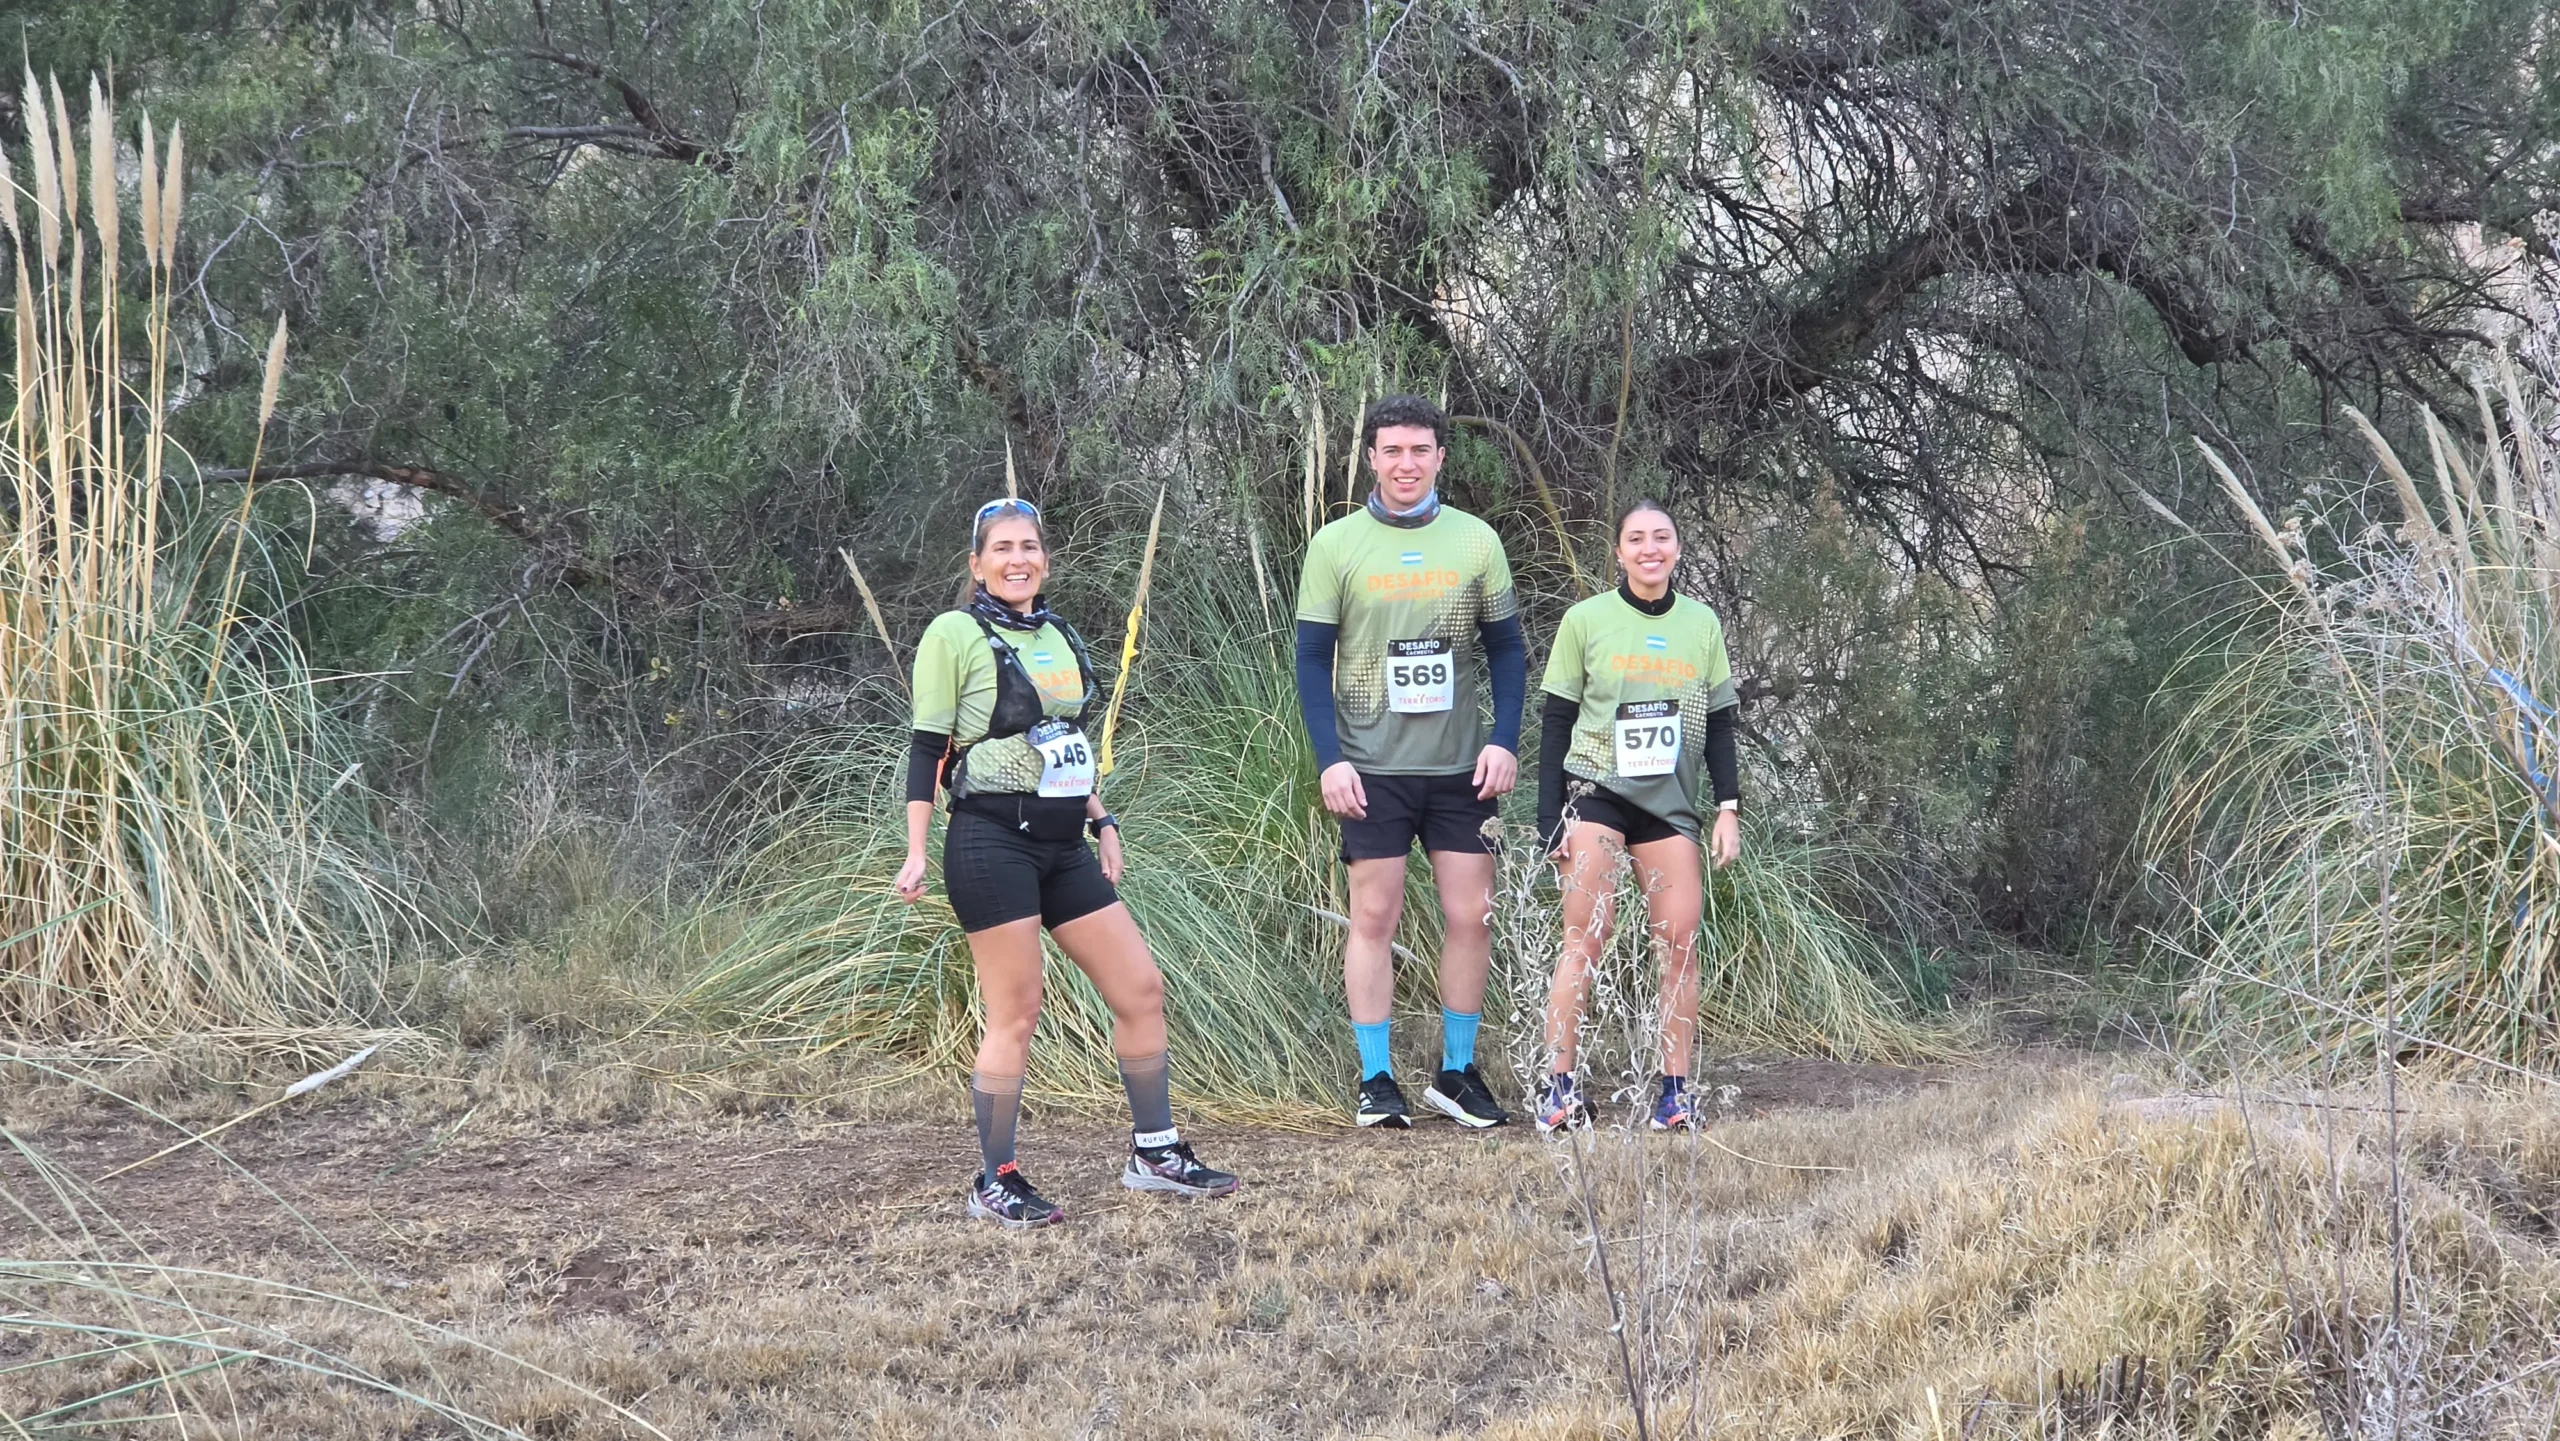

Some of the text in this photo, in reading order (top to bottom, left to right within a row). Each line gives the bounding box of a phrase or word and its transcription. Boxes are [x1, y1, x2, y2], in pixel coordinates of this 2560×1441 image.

[1399, 639, 1440, 651] DESAFÍO
[1393, 663, 1447, 687] 569
[1628, 700, 1668, 713] DESAFÍO
[1624, 725, 1675, 750] 570
[1050, 742, 1087, 769] 146
